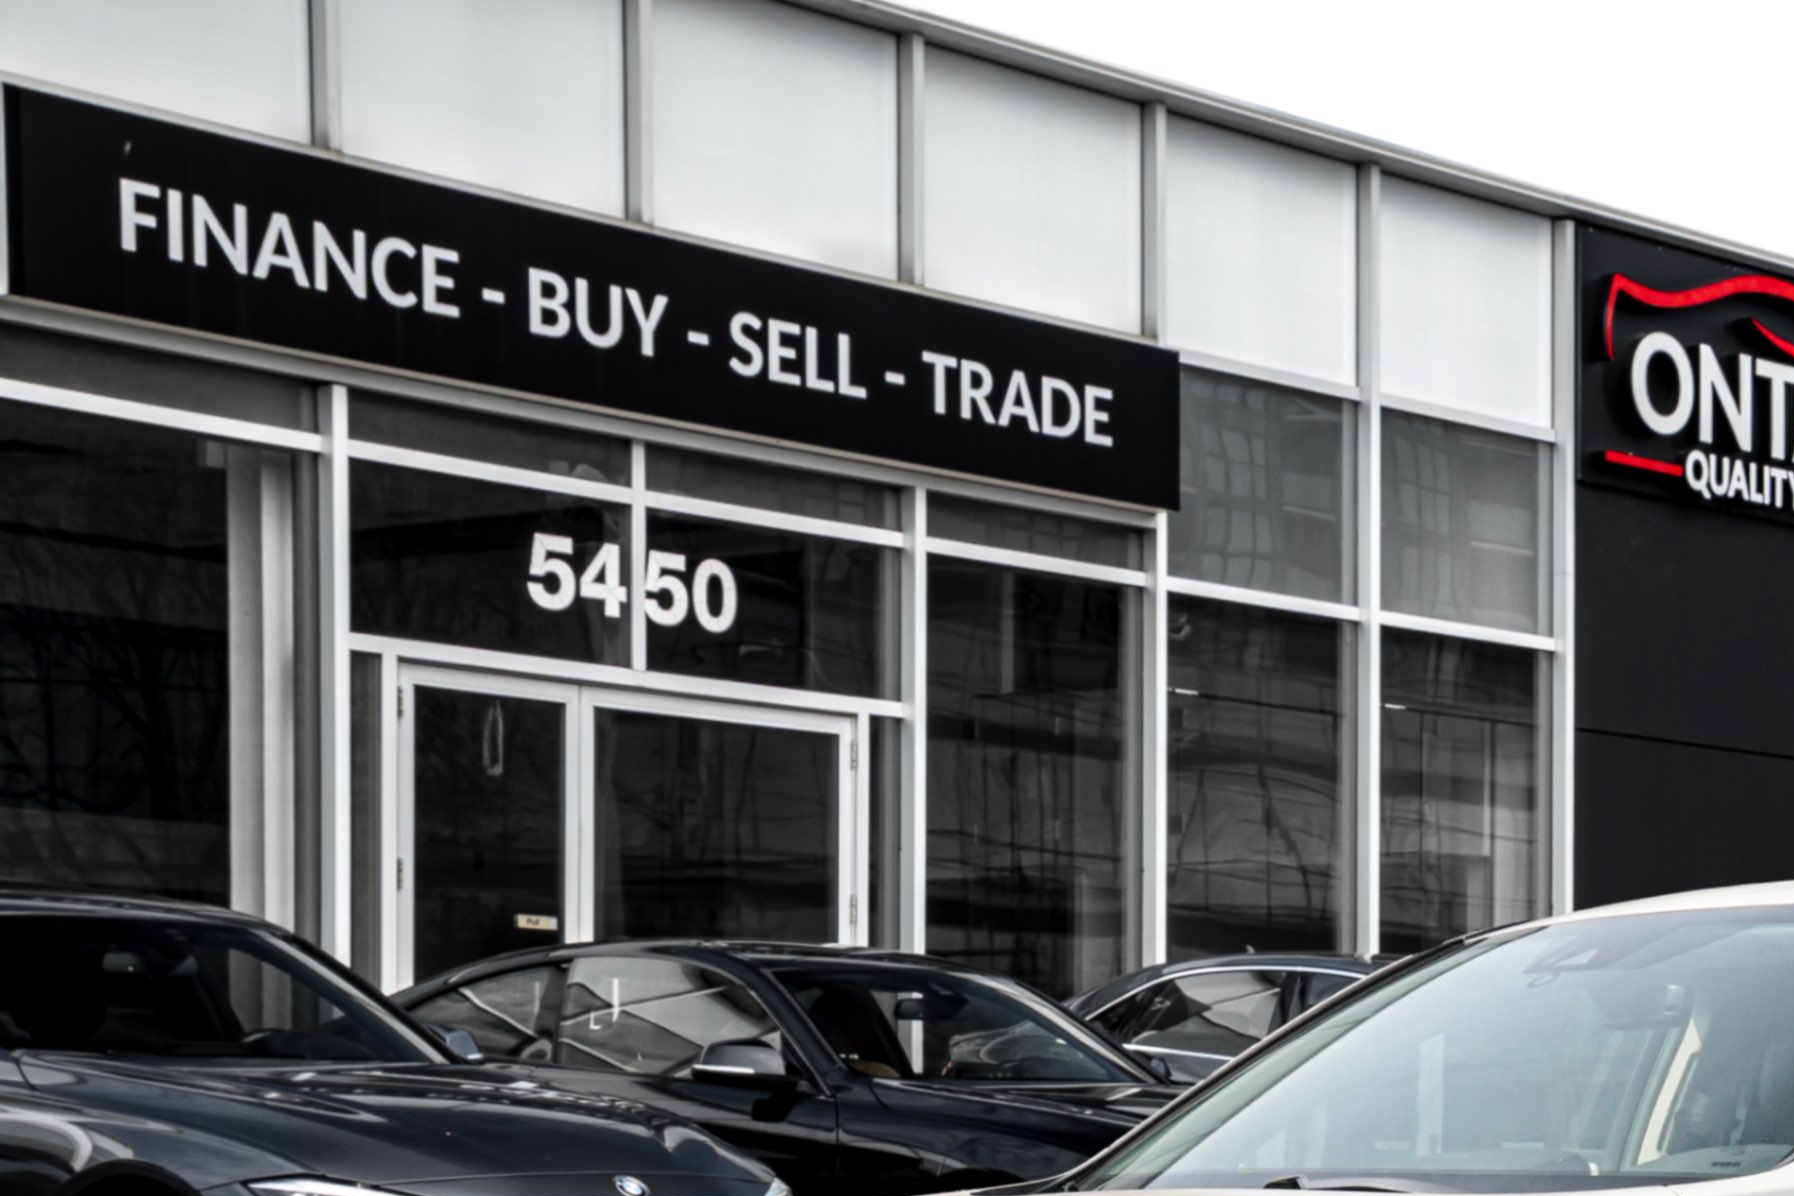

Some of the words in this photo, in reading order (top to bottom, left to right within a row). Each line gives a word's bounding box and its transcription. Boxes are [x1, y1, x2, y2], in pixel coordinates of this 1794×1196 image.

[119, 177, 460, 319] FINANCE
[528, 267, 669, 357] BUY
[729, 311, 867, 399] SELL
[921, 350, 1113, 447] TRADE
[527, 532, 738, 633] 5450
